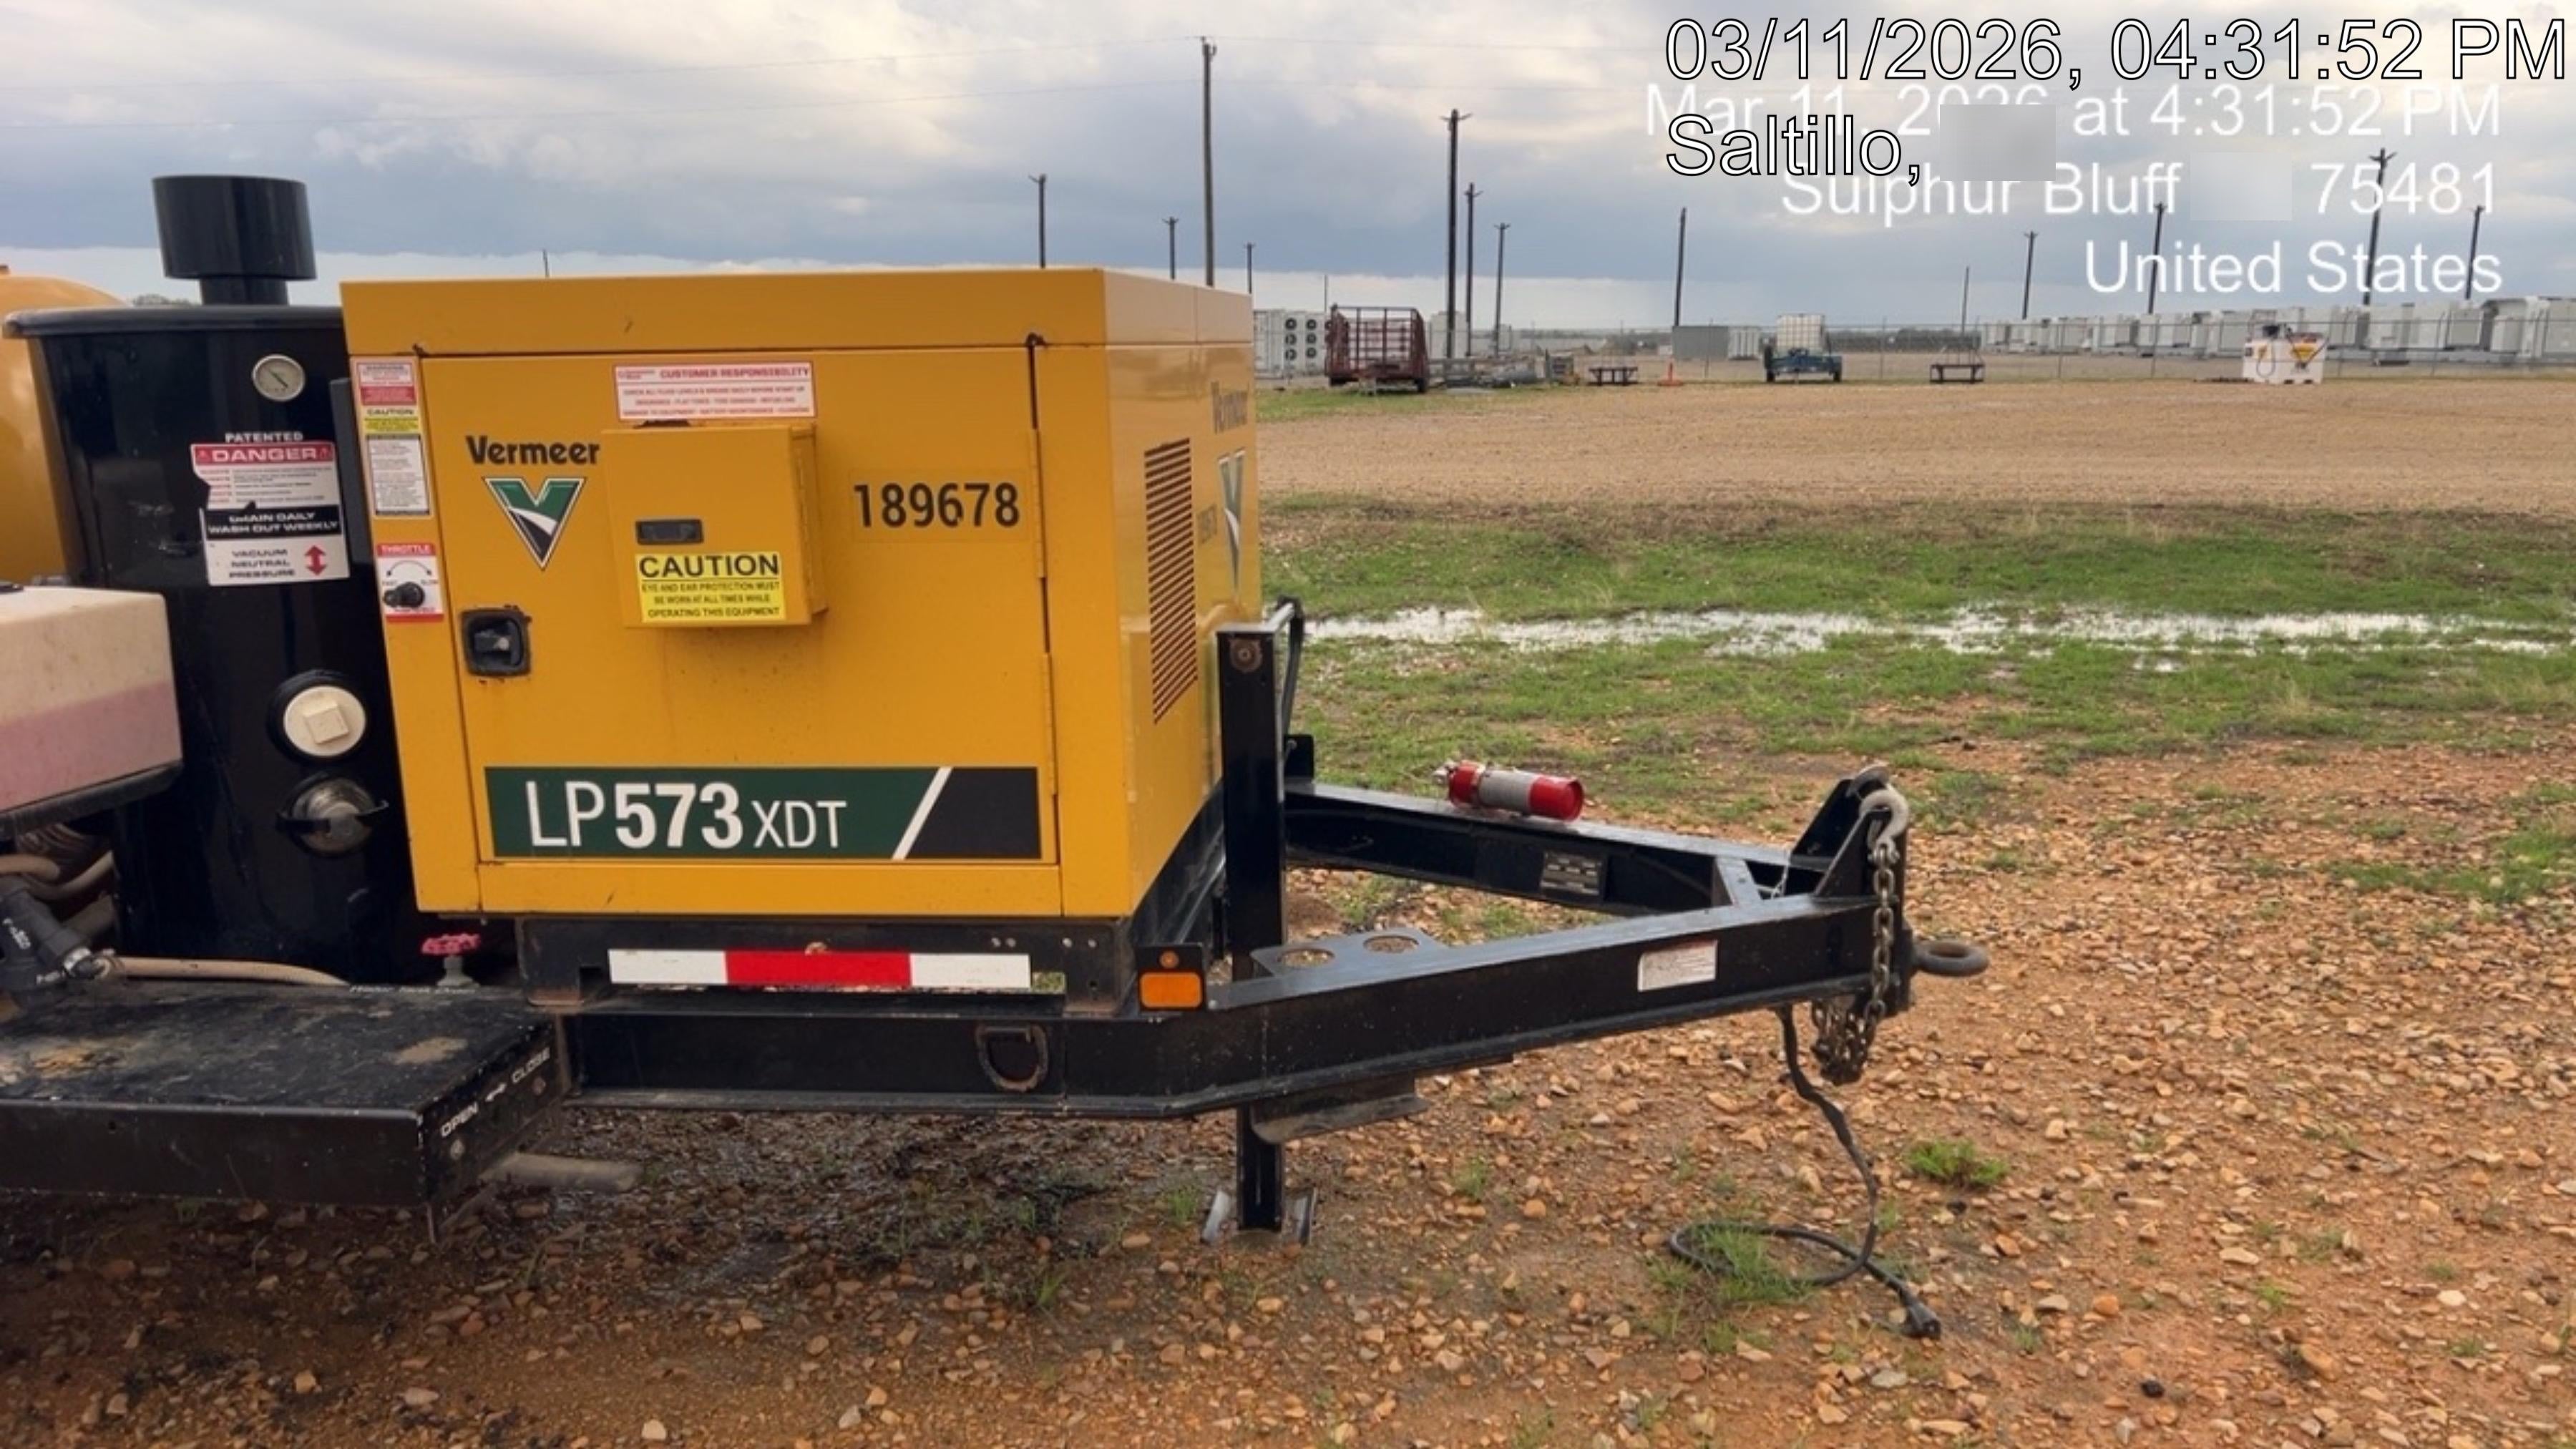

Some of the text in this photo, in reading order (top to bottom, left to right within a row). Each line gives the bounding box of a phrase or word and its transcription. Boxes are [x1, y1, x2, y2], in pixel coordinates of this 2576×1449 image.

[661, 368, 718, 379] CUSTOMER
[721, 366, 809, 377] RESPONSIBILITY
[225, 431, 303, 443] PATENTED
[212, 448, 317, 463] DANGER
[465, 435, 600, 465] Vermeer
[854, 482, 1020, 528] 189678
[276, 512, 316, 521] DAILY
[208, 522, 338, 534] WASH OUT WEEKLY
[232, 549, 288, 557] VACUUM
[639, 554, 779, 578] CAUTION
[229, 570, 296, 578] PRESSURE
[641, 583, 658, 592] EYE
[660, 583, 678, 592] AND
[700, 582, 753, 590] PROTECTION
[756, 581, 780, 590] MUST
[721, 594, 743, 602] TIMES
[648, 607, 780, 618] OPERATING THIS EQUIPMENT
[440, 1101, 479, 1138] OPEN
